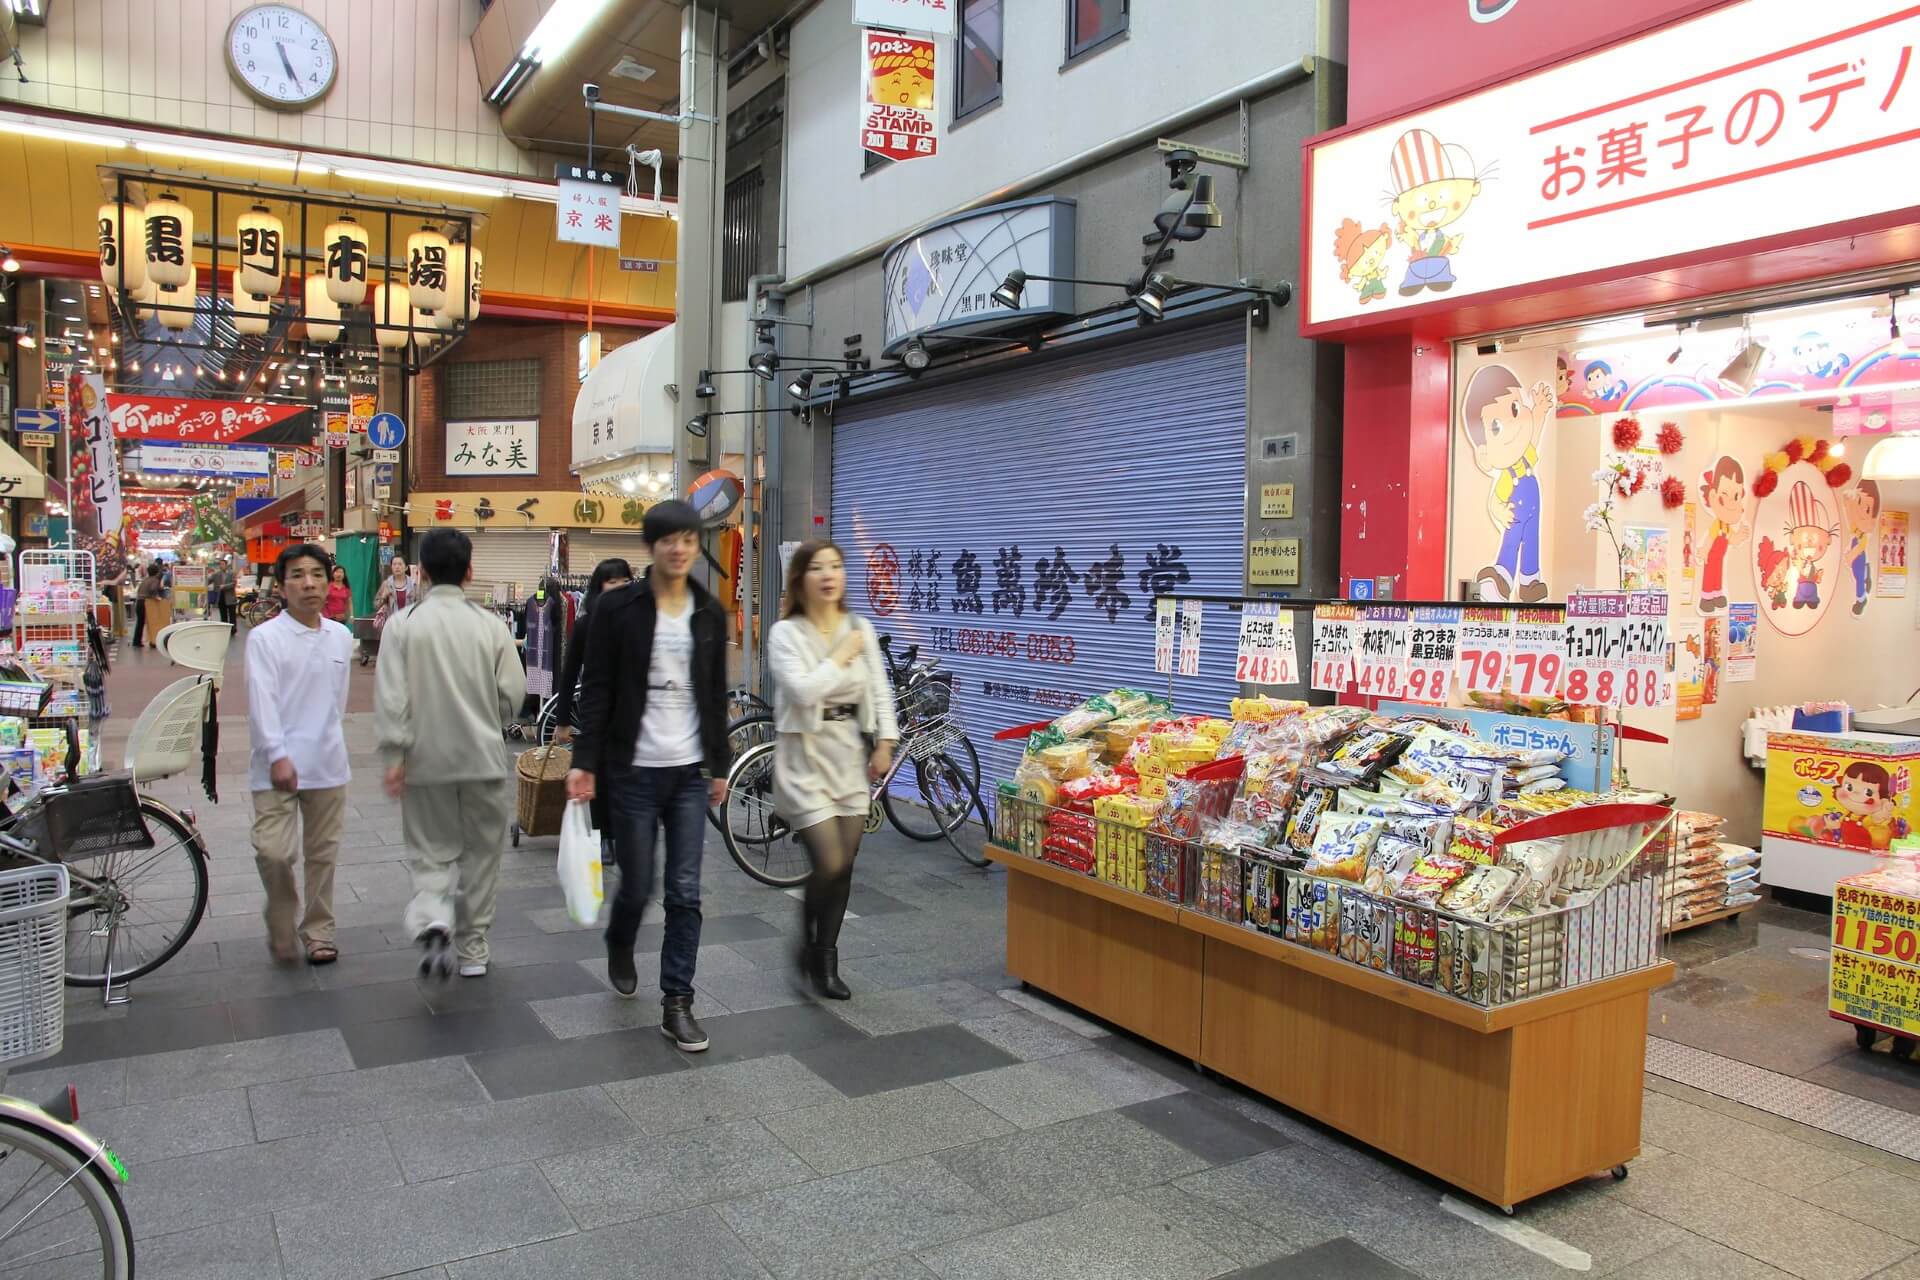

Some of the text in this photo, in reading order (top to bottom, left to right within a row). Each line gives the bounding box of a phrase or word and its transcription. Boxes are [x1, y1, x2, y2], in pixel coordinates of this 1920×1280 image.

[246, 26, 258, 39] 10
[278, 15, 289, 29] 12
[242, 42, 250, 54] 9
[310, 38, 319, 50] 2
[247, 60, 256, 72] 8
[314, 56, 323, 68] 3
[262, 75, 270, 87] 7
[279, 82, 287, 94] 6
[309, 72, 318, 83] 4
[872, 104, 926, 121] フレッシュ
[1541, 46, 1913, 200] お菓子のデ
[866, 115, 933, 134] STAMP
[866, 132, 933, 152] 加盟店
[565, 210, 613, 231] 京栄
[930, 243, 967, 268] 珍味堂
[466, 424, 515, 436] 大阪 黒門
[454, 439, 529, 469] みな美
[84, 415, 108, 534] コーヒー
[1372, 606, 1401, 618] おすすめ
[1577, 597, 1617, 614] 数量限定
[1321, 624, 1348, 639] がんばれ
[1362, 626, 1406, 656] 木の実アソート
[1412, 628, 1456, 644] おつまみ
[1566, 625, 1627, 658] チョコフレーク
[1626, 622, 1664, 655] エースコイン
[1237, 655, 1269, 682] 248
[1312, 661, 1345, 690] 148
[1461, 650, 1502, 690] 79
[1515, 653, 1561, 695] 79
[1360, 665, 1397, 694] 498
[1409, 668, 1445, 699] 98
[1625, 668, 1657, 707] 88
[1493, 725, 1577, 757] ポコちゃん
[1793, 758, 1840, 780] ポップ
[1842, 953, 1917, 985] 生ナッツの食べ方
